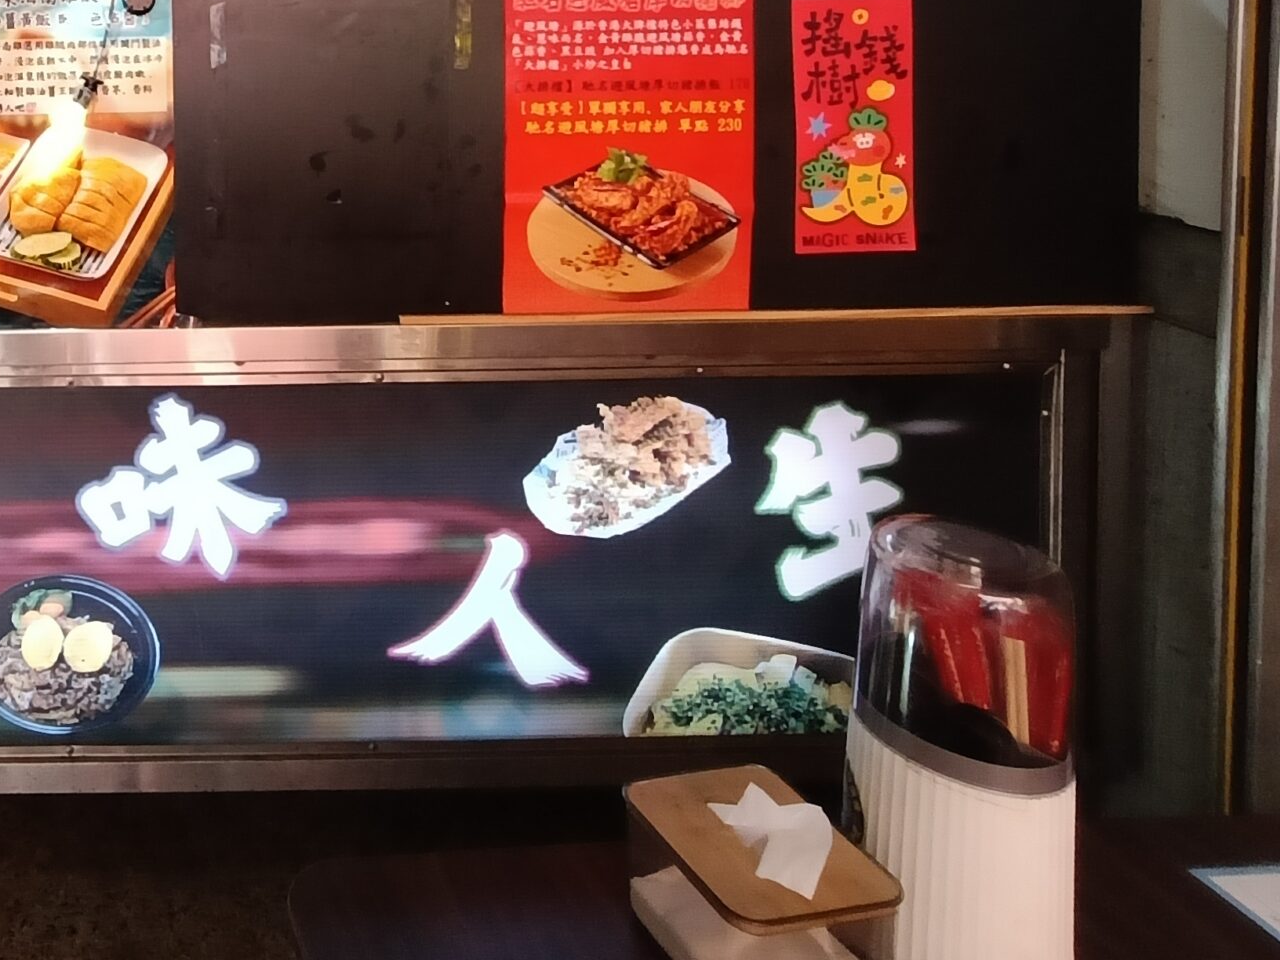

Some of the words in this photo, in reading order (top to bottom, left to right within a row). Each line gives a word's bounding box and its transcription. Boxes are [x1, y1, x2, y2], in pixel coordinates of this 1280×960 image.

[718, 118, 742, 132] 230
[802, 232, 848, 247] MAGIC
[855, 231, 908, 246] SNAKE
